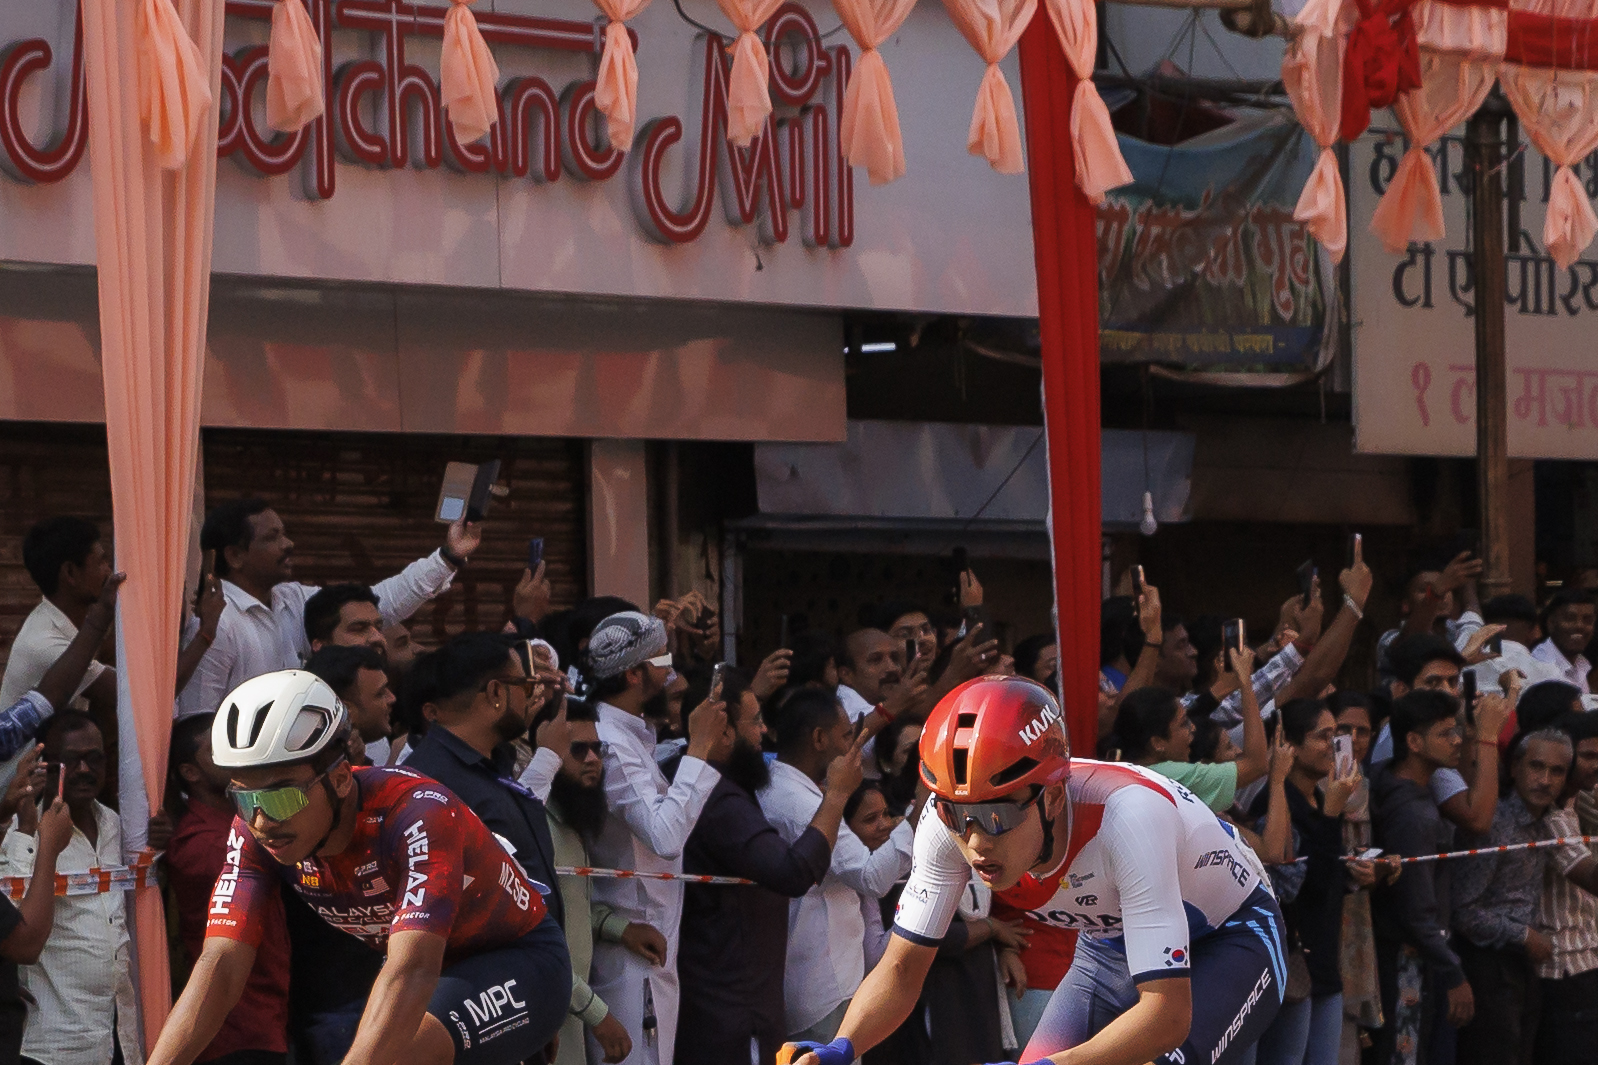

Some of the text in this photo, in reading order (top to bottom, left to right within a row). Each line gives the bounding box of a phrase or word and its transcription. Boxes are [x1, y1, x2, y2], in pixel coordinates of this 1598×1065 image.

[210, 828, 245, 914] HELAZ
[402, 820, 429, 910] HELAZ
[498, 861, 530, 911] MZSB
[1194, 849, 1251, 888] WINSPACE
[463, 979, 526, 1027] MPC
[1211, 967, 1272, 1065] WINSPACE
